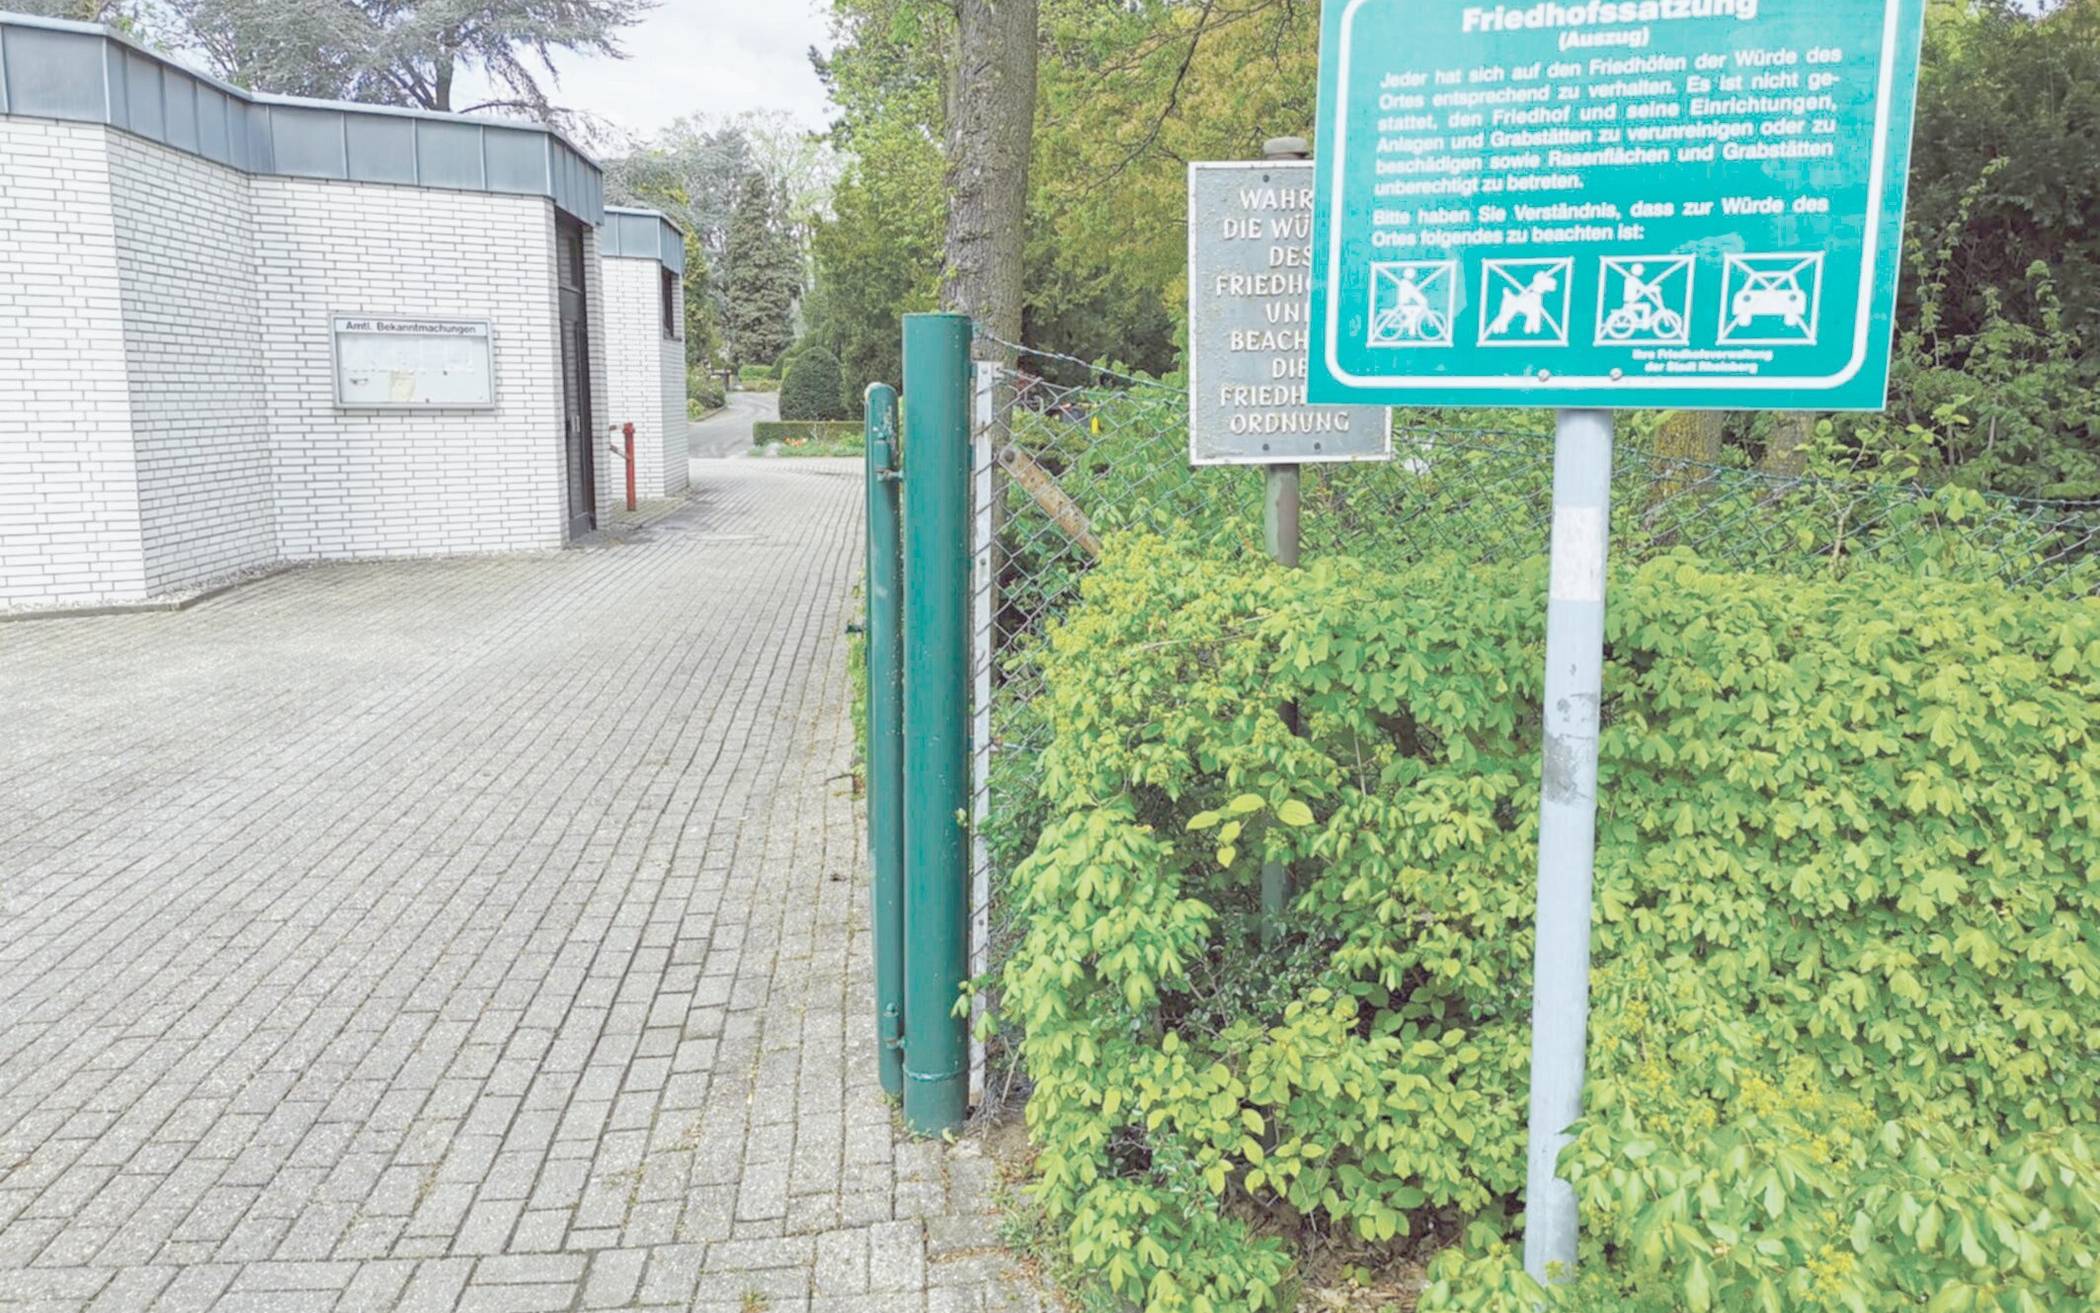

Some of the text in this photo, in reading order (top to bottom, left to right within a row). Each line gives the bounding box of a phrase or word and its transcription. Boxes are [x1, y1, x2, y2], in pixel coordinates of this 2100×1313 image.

[1462, 0, 1757, 32] Friedhofssatzung
[1558, 27, 1649, 51] (Auszug)
[1380, 46, 1842, 88] Jeder hat sich auf den Friedhöfen der Würde des
[1379, 71, 1840, 110] Ortes entsprechend zu verhalten. Es ist nicht ge-
[1377, 95, 1837, 132] stattet, den Friedhof und seine Einrichtungen,
[1377, 118, 1836, 154] Anlagen und Grabstätten zu verunreinigen oder zu
[1376, 141, 1833, 175] beschädigen sowie Rasenflächen und Grabstätten
[1374, 174, 1583, 196] unberechtigt zu betreten.
[1373, 195, 1829, 225] Bitte haben Sie Verständnis, dass zur Würde des
[1223, 218, 1261, 239] DIE
[1372, 224, 1645, 248] Ortes folgendes zu beachten ist:
[1269, 247, 1311, 268] DES
[1230, 413, 1350, 434] ORDNUNG
